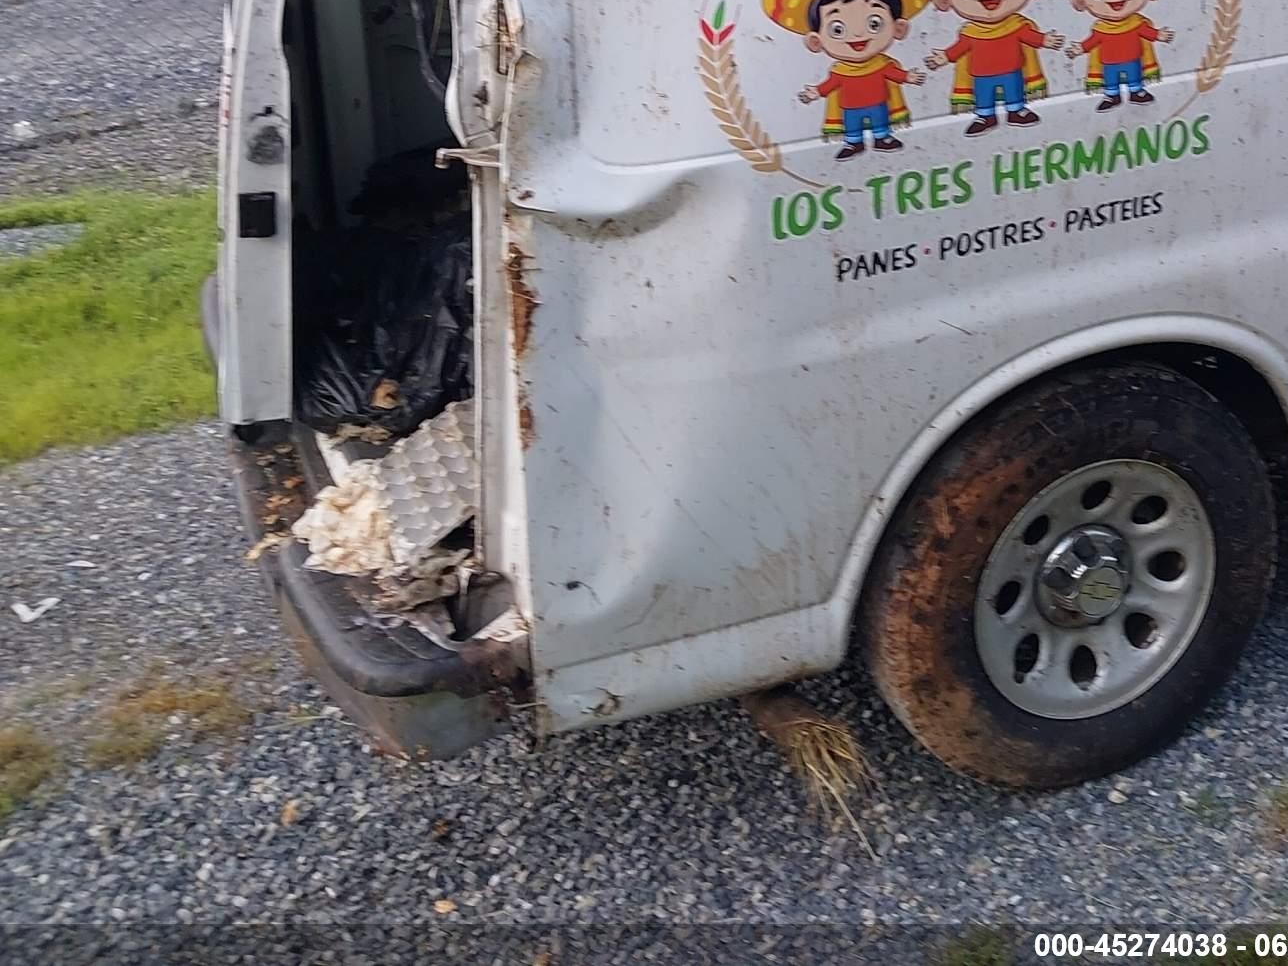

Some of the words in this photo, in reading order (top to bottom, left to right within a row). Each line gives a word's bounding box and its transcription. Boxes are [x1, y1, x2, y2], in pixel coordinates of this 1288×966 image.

[771, 185, 843, 239] LOS
[866, 161, 973, 220] TRES
[993, 115, 1210, 196] HERMANOS
[836, 244, 916, 283] PANES
[940, 218, 1045, 262] POSTRES
[1064, 192, 1163, 231] PASTELES
